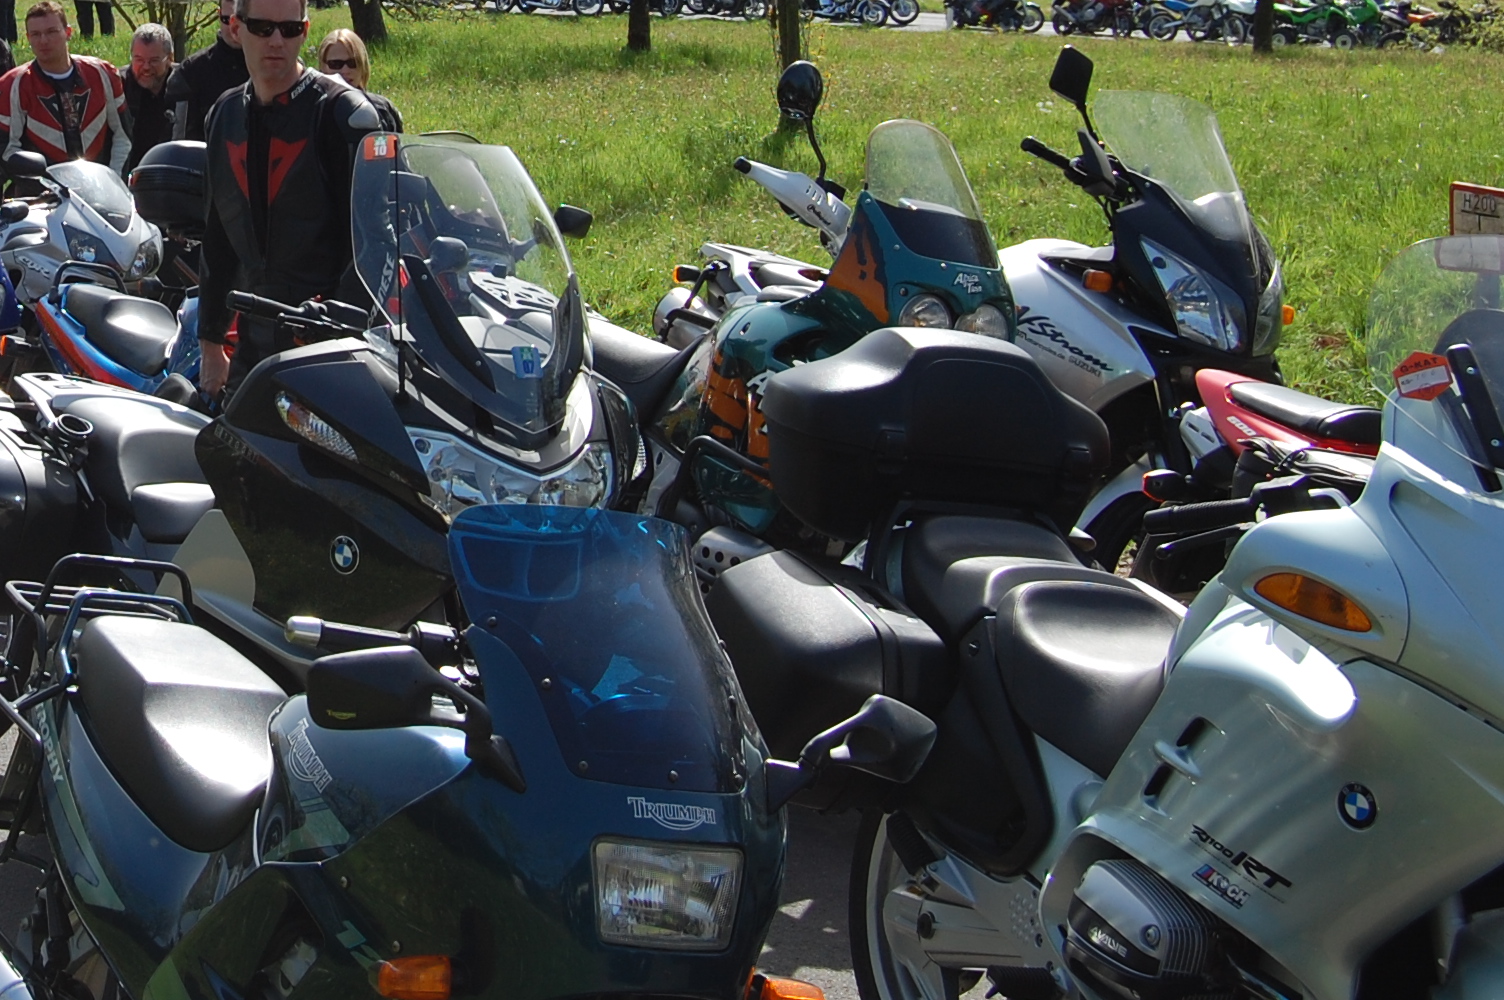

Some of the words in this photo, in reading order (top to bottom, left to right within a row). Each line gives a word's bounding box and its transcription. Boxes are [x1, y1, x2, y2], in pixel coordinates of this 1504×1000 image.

[372, 144, 387, 157] 10
[1069, 355, 1102, 378] SUZUKI
[287, 717, 333, 794] TRIUMPH
[627, 796, 716, 830] TRIUMPH
